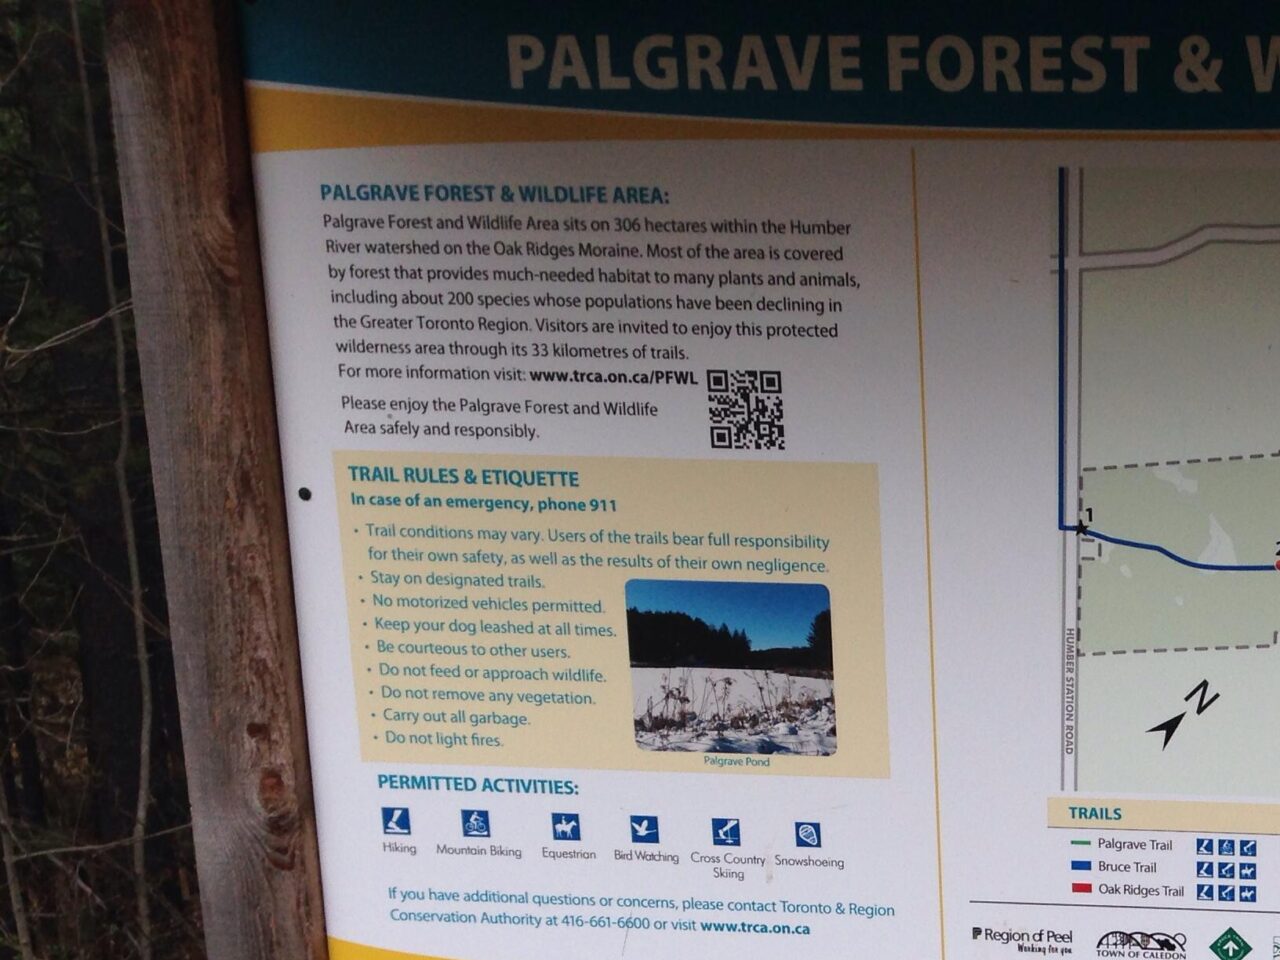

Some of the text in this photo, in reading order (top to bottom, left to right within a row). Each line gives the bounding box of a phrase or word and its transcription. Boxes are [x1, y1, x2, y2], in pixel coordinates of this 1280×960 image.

[506, 34, 863, 92] PALGRAVE
[886, 34, 1150, 92] FOREST
[1174, 34, 1223, 93] &
[320, 184, 669, 204] PALGRAVE FOREST & WILDLIFE AREA:
[323, 214, 851, 236] Palgrave Forest and Wildlife Area sits on 306 hectares within the Humber
[331, 289, 842, 316] including about 200 species whose populations have been declining in
[338, 364, 698, 385] For more information visit: www.trca.on.ca/PFWL
[348, 466, 579, 488] TRAIL RULES & ETIQUETTE
[351, 493, 617, 514] In case of an emergency, phone 911
[1085, 508, 1093, 522] 1
[370, 570, 545, 589] Stay on designated trails.
[373, 594, 605, 615] No motorized vehicles permitted.
[1066, 628, 1074, 755] HUMBER STATION ROAD
[386, 730, 504, 748] Do not light fires.
[704, 756, 770, 768] Palgrave Pond
[378, 774, 578, 795] PERMITTED ACTIVITIES:
[1069, 807, 1122, 820] TRAILS
[383, 842, 417, 856] Hiking
[436, 844, 522, 859] Mountain Biking
[542, 846, 596, 860] Equestrian
[1098, 838, 1172, 852] Palgrave Trail
[614, 849, 679, 864] Bird Watching
[690, 851, 766, 867] Cross Country
[775, 854, 844, 870] Snowshoeing
[713, 867, 744, 882] Skiing
[1099, 861, 1156, 873] Bruce Trail
[1099, 884, 1184, 898] Oak Ridges Trail
[390, 909, 810, 935] Conservation Authority at 416-661-6600 or visit www.trca.on.ca
[985, 928, 1030, 944] Region
[1047, 930, 1072, 943] Peel
[1143, 952, 1186, 960] CALEDON
